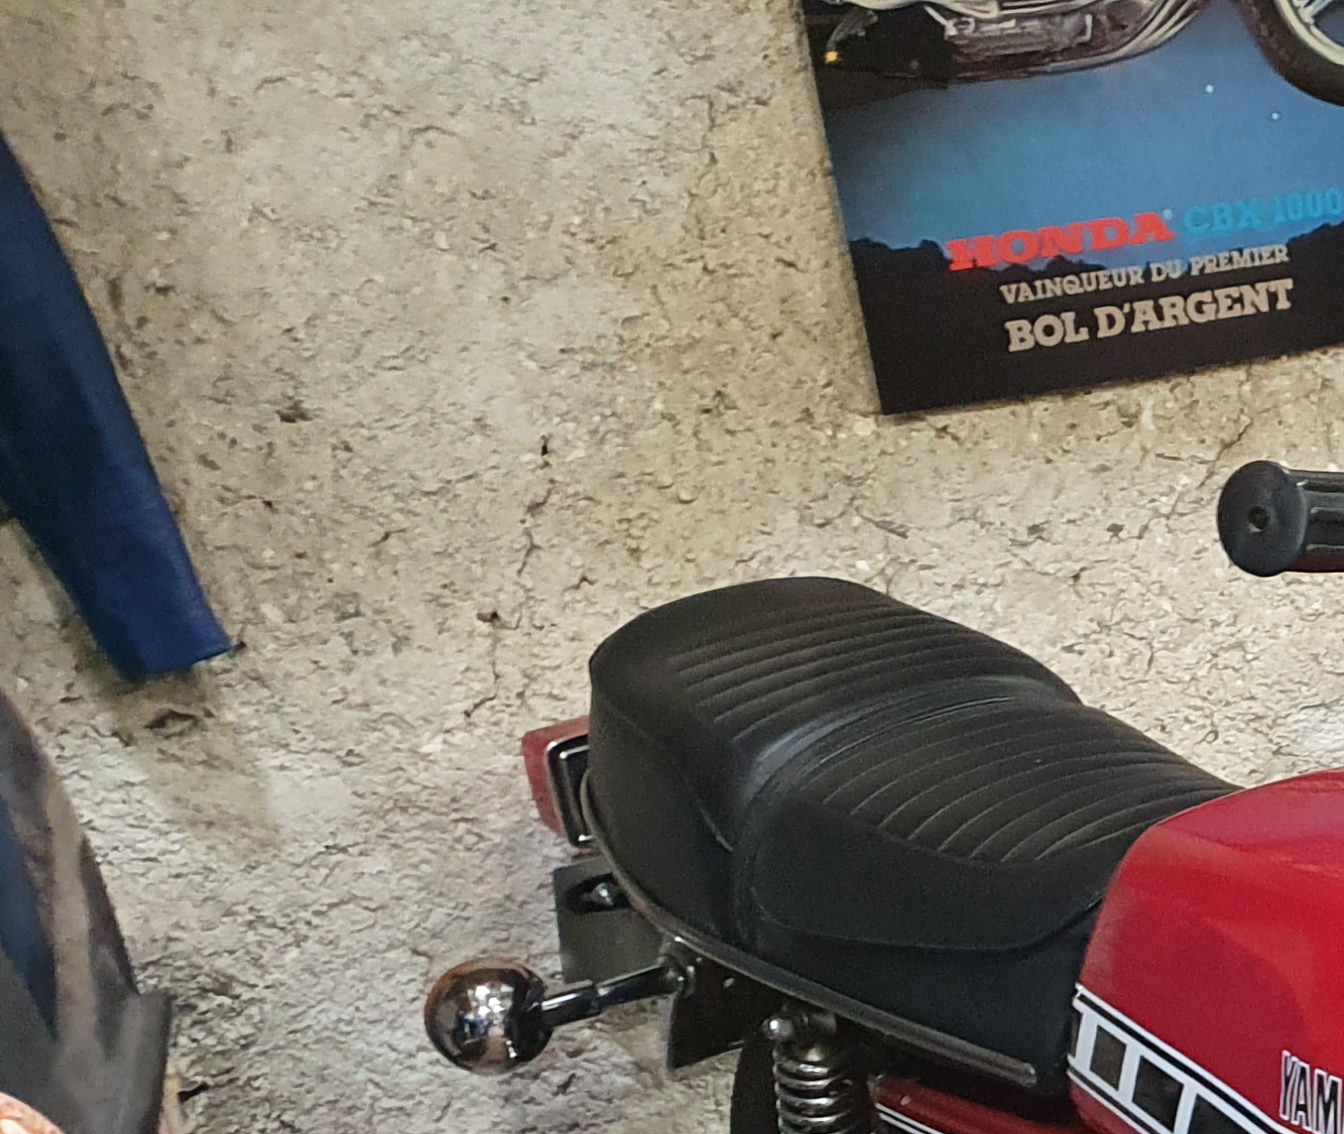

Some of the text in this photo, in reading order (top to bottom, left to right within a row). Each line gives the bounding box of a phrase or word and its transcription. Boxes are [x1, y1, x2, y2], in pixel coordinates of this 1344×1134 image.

[946, 211, 1176, 271] HONDA
[1182, 198, 1258, 235] CBX
[1000, 243, 1290, 304] VAINQUEUR DU PREMIER
[1004, 278, 1294, 353] BOL D'ARGENT
